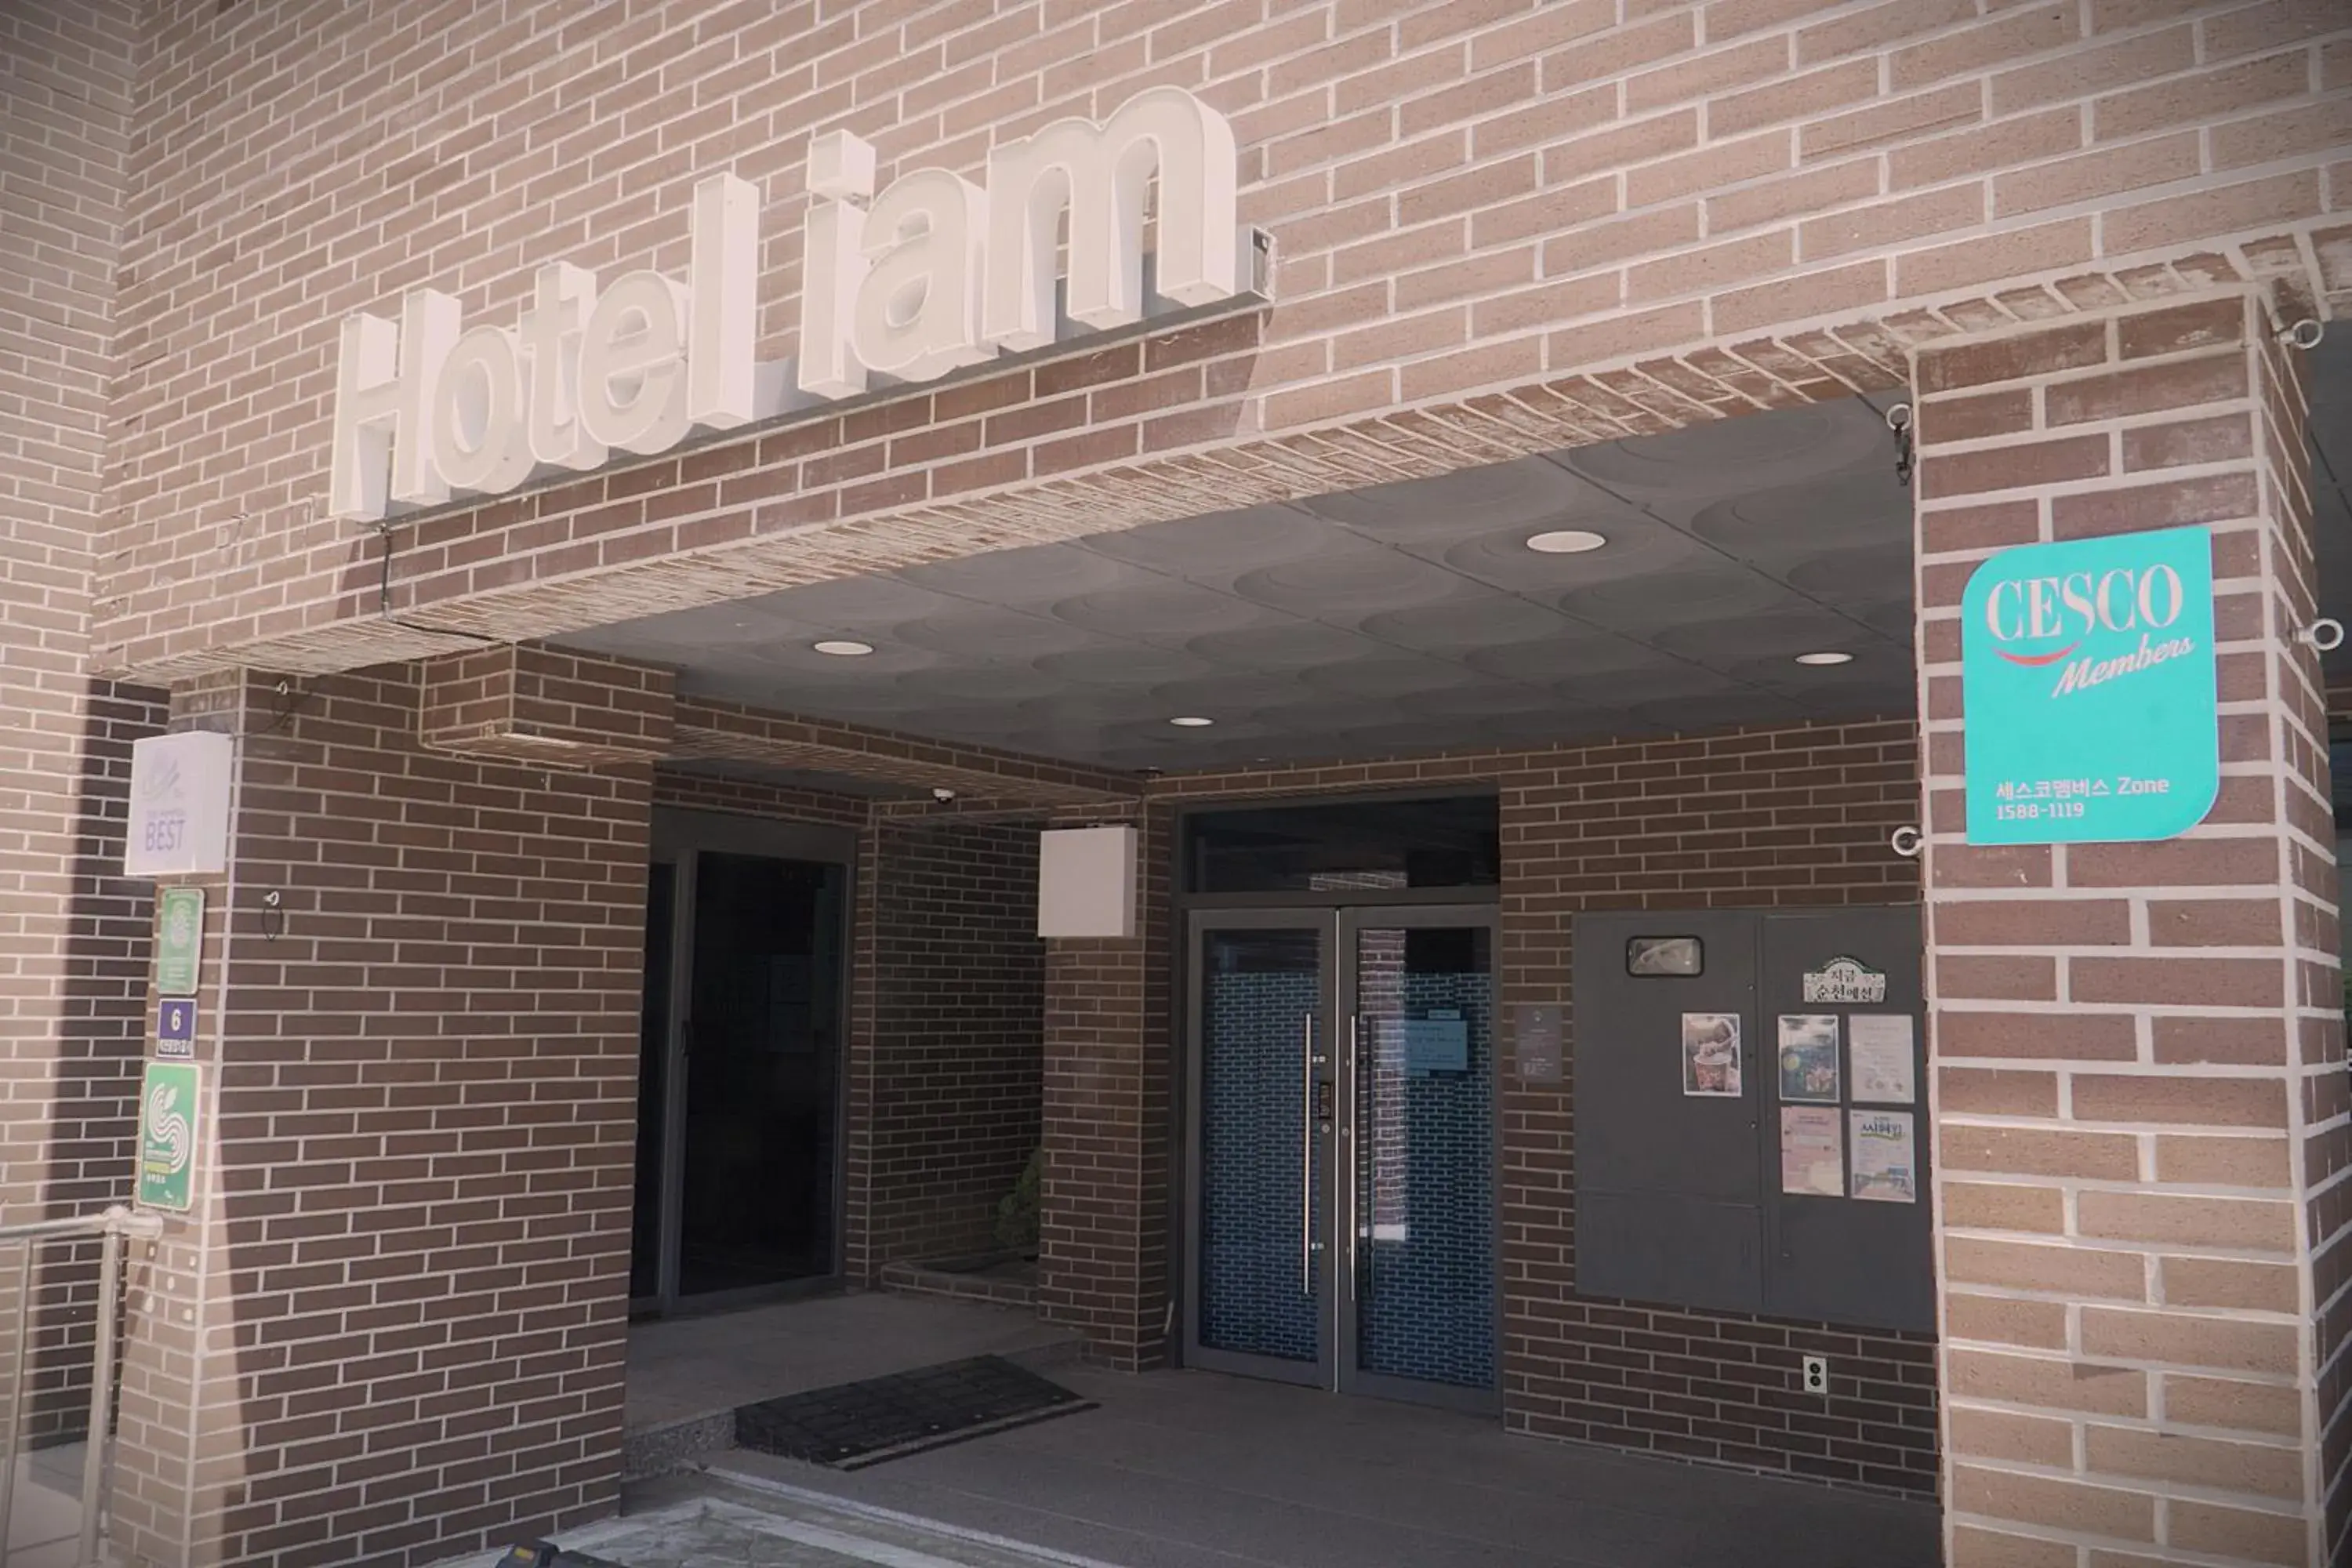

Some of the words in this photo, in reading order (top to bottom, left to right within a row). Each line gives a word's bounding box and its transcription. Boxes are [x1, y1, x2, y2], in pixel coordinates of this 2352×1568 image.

[329, 170, 760, 524] Hotel
[797, 84, 1237, 398] iam
[1985, 563, 2183, 641] CESCO
[2050, 633, 2195, 699] Members
[1995, 778, 2111, 800] 세스코멤버스
[2118, 776, 2170, 795] Zone
[1997, 802, 2085, 820] 1588-1119
[145, 819, 187, 852] BEST
[171, 1008, 182, 1031] 6
